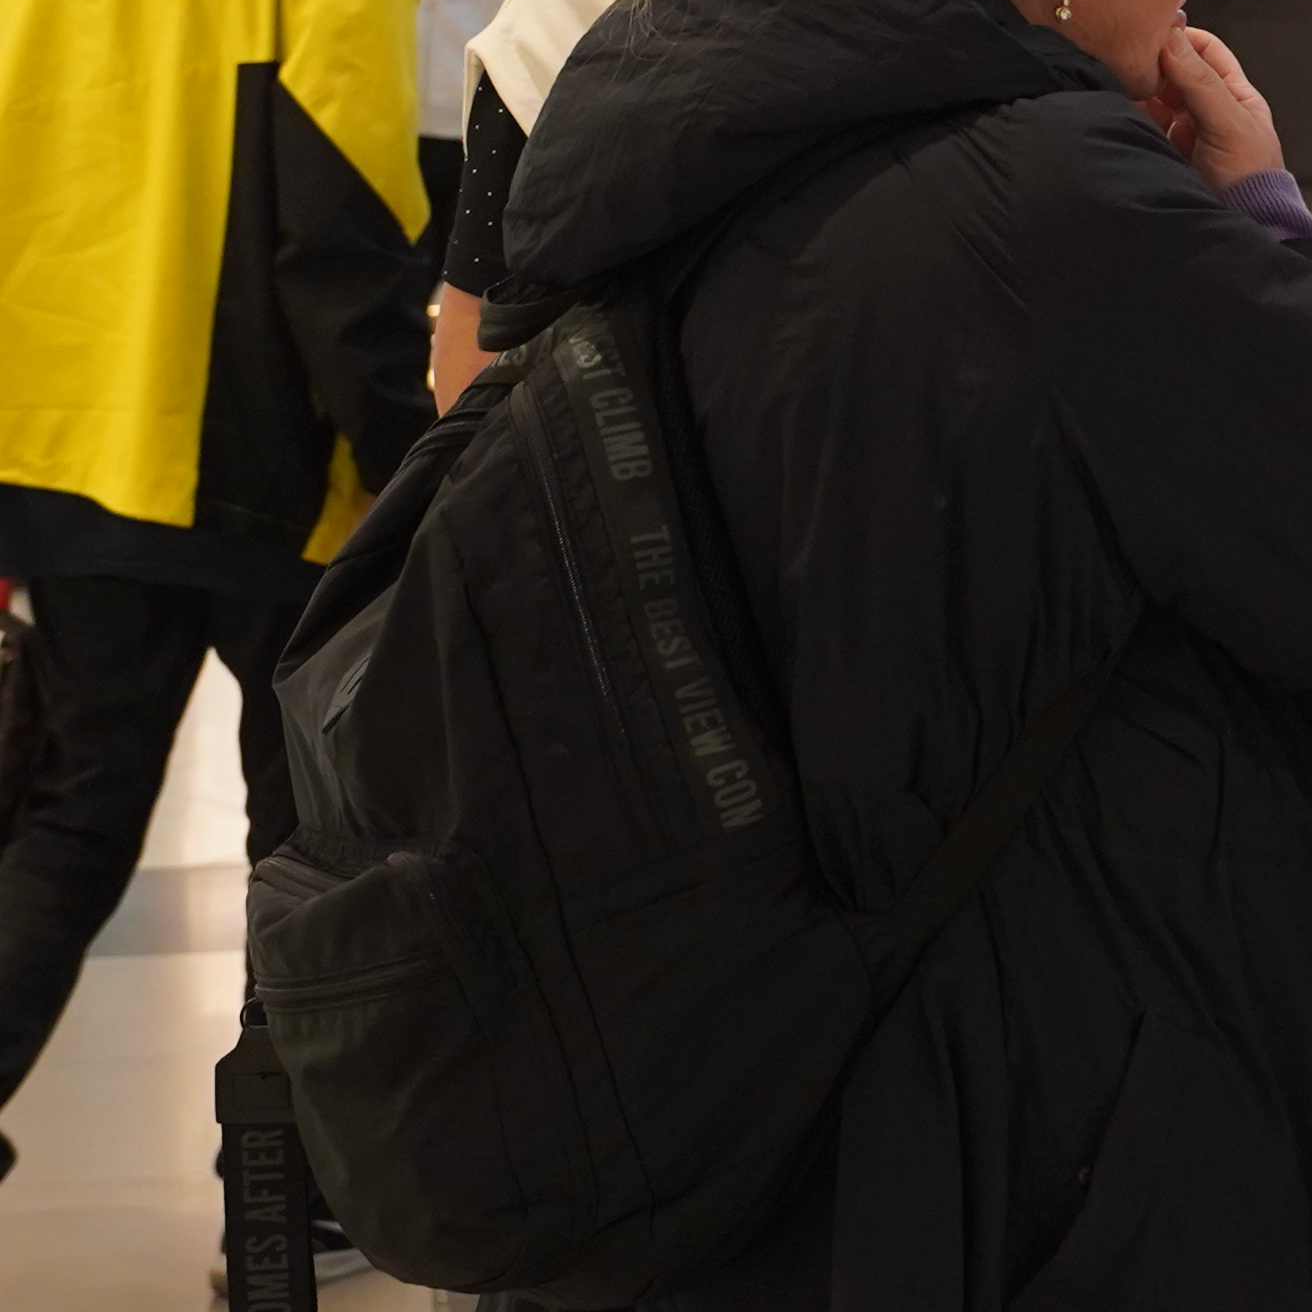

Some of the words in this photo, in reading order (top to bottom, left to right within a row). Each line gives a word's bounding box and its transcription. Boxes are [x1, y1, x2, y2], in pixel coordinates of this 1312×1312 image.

[591, 387, 653, 482] CLIMB
[630, 524, 677, 592] THE
[643, 595, 696, 671] BEST
[674, 675, 738, 758] VIEW
[241, 1129, 287, 1224] AFTER
